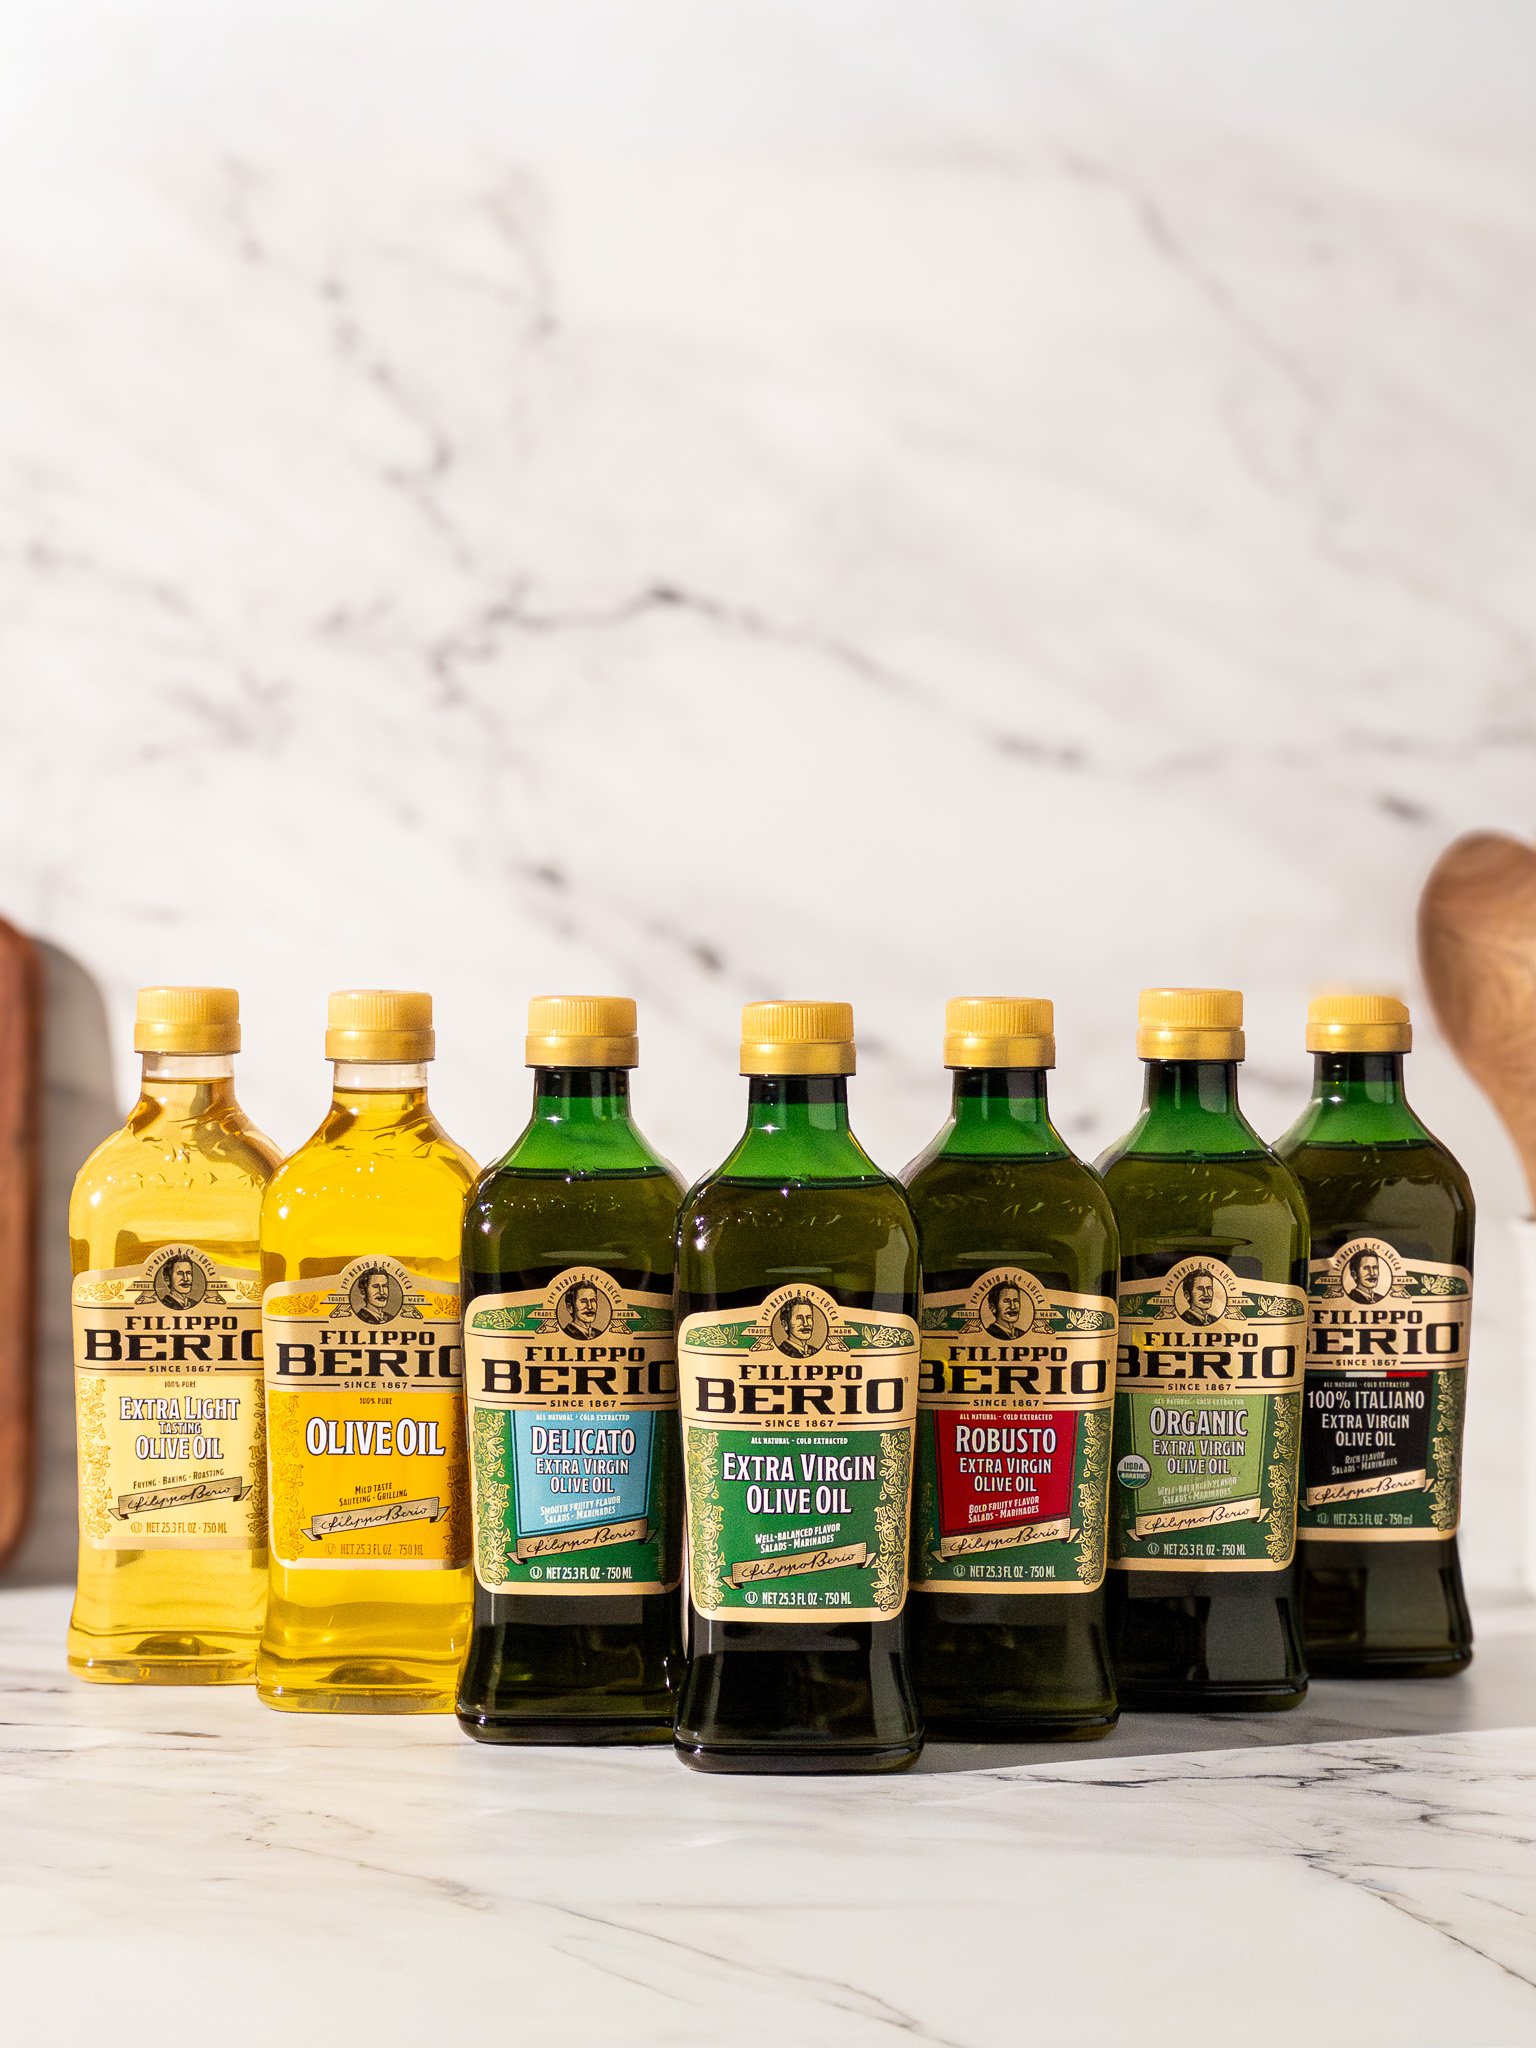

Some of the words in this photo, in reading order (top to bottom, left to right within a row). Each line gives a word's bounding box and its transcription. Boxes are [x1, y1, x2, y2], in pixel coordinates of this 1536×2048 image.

[770, 1291, 793, 1309] BERIO
[820, 1297, 839, 1321] LUCCA
[125, 1316, 238, 1330] FILIPPO
[1312, 1310, 1422, 1324] FILIPPO
[319, 1330, 435, 1345] FILIPPO
[1144, 1332, 1258, 1347] FILIPPO
[1307, 1322, 1459, 1355] ERIO
[525, 1347, 645, 1362] FILIPPO
[949, 1347, 1067, 1361] FILIPPO
[739, 1365, 863, 1380] FILIPPO
[695, 1377, 903, 1415] BERIO
[973, 1399, 1007, 1407] SINCE
[1308, 1391, 1350, 1409] 100%
[1355, 1391, 1424, 1409] ITALIANO
[120, 1396, 181, 1420] EXTRA
[184, 1396, 240, 1420] LIGHT
[159, 1421, 201, 1434] TASTING
[1150, 1407, 1248, 1436] ORGANIC
[1322, 1414, 1362, 1429] EXTRA
[1367, 1414, 1409, 1429] VIRGIN
[306, 1417, 393, 1456] OLIVE
[396, 1418, 446, 1456] OIL
[531, 1426, 636, 1455] DELICATO
[813, 1437, 848, 1445] EXTRACTED
[956, 1425, 1056, 1454] ROBUSTO
[1335, 1431, 1372, 1446] OLIVE
[1375, 1431, 1395, 1446] OIL
[135, 1435, 189, 1460] OLIVE
[193, 1436, 224, 1460] OIL
[1153, 1439, 1195, 1455] EXTRA
[1200, 1440, 1245, 1456] VIRGIN
[1361, 1452, 1385, 1461] FLAVOR
[536, 1458, 579, 1474] EXTRA
[583, 1459, 629, 1475] VIRGIN
[722, 1452, 795, 1481] EXTRA
[800, 1453, 876, 1482] VIRGIN
[960, 1458, 1002, 1473] EXTRA
[1006, 1458, 1052, 1473] VIRGIN
[1124, 1462, 1143, 1470] USDA
[1167, 1458, 1205, 1474] OLIVE
[1208, 1459, 1230, 1474] OIL
[374, 1483, 392, 1491] TASTE
[551, 1476, 589, 1493] OLIVE
[592, 1477, 615, 1493] OIL
[974, 1475, 1012, 1492] OLIVE
[1015, 1476, 1037, 1492] OIL
[570, 1500, 594, 1511] FRUITY
[595, 1496, 620, 1507] FLAVOR
[746, 1485, 811, 1514] OLIVE
[815, 1485, 852, 1514] OIL
[988, 1500, 1013, 1511] FRUITY
[1014, 1496, 1039, 1505] FLAVOR
[1334, 1514, 1346, 1524] NET
[1348, 1514, 1363, 1525] 25.3
[1365, 1514, 1373, 1525] FL
[1374, 1514, 1383, 1525] OZ
[1389, 1514, 1402, 1524] 750
[146, 1522, 160, 1533] NET
[161, 1522, 177, 1533] 25.3
[178, 1523, 187, 1533] FL
[188, 1523, 197, 1533] OZ
[204, 1523, 216, 1533] 750
[218, 1523, 227, 1533] ML
[814, 1523, 841, 1536] FLAVOR
[761, 1541, 787, 1553] SALADS
[1164, 1544, 1176, 1555] NET
[1180, 1544, 1195, 1555] 25.3
[1196, 1544, 1205, 1555] FL
[1206, 1544, 1215, 1555] OZ
[1222, 1544, 1235, 1555] 750
[1237, 1544, 1246, 1555] ML
[546, 1567, 561, 1579] NET
[562, 1567, 579, 1579] 25.3
[580, 1567, 589, 1579] FL
[591, 1567, 600, 1579] OZ
[608, 1567, 621, 1579] 750
[622, 1567, 632, 1579] ML
[970, 1566, 985, 1578] NET
[986, 1566, 1002, 1578] 25.3
[1004, 1566, 1012, 1578] FL
[1014, 1566, 1023, 1578] OZ
[1030, 1566, 1044, 1578] 750
[1045, 1566, 1056, 1578] ML
[762, 1593, 777, 1604] NET
[779, 1593, 795, 1604] 25.3
[797, 1593, 807, 1604] FL
[808, 1593, 817, 1604] OZ
[825, 1593, 839, 1604] 750
[841, 1593, 852, 1604] ML
